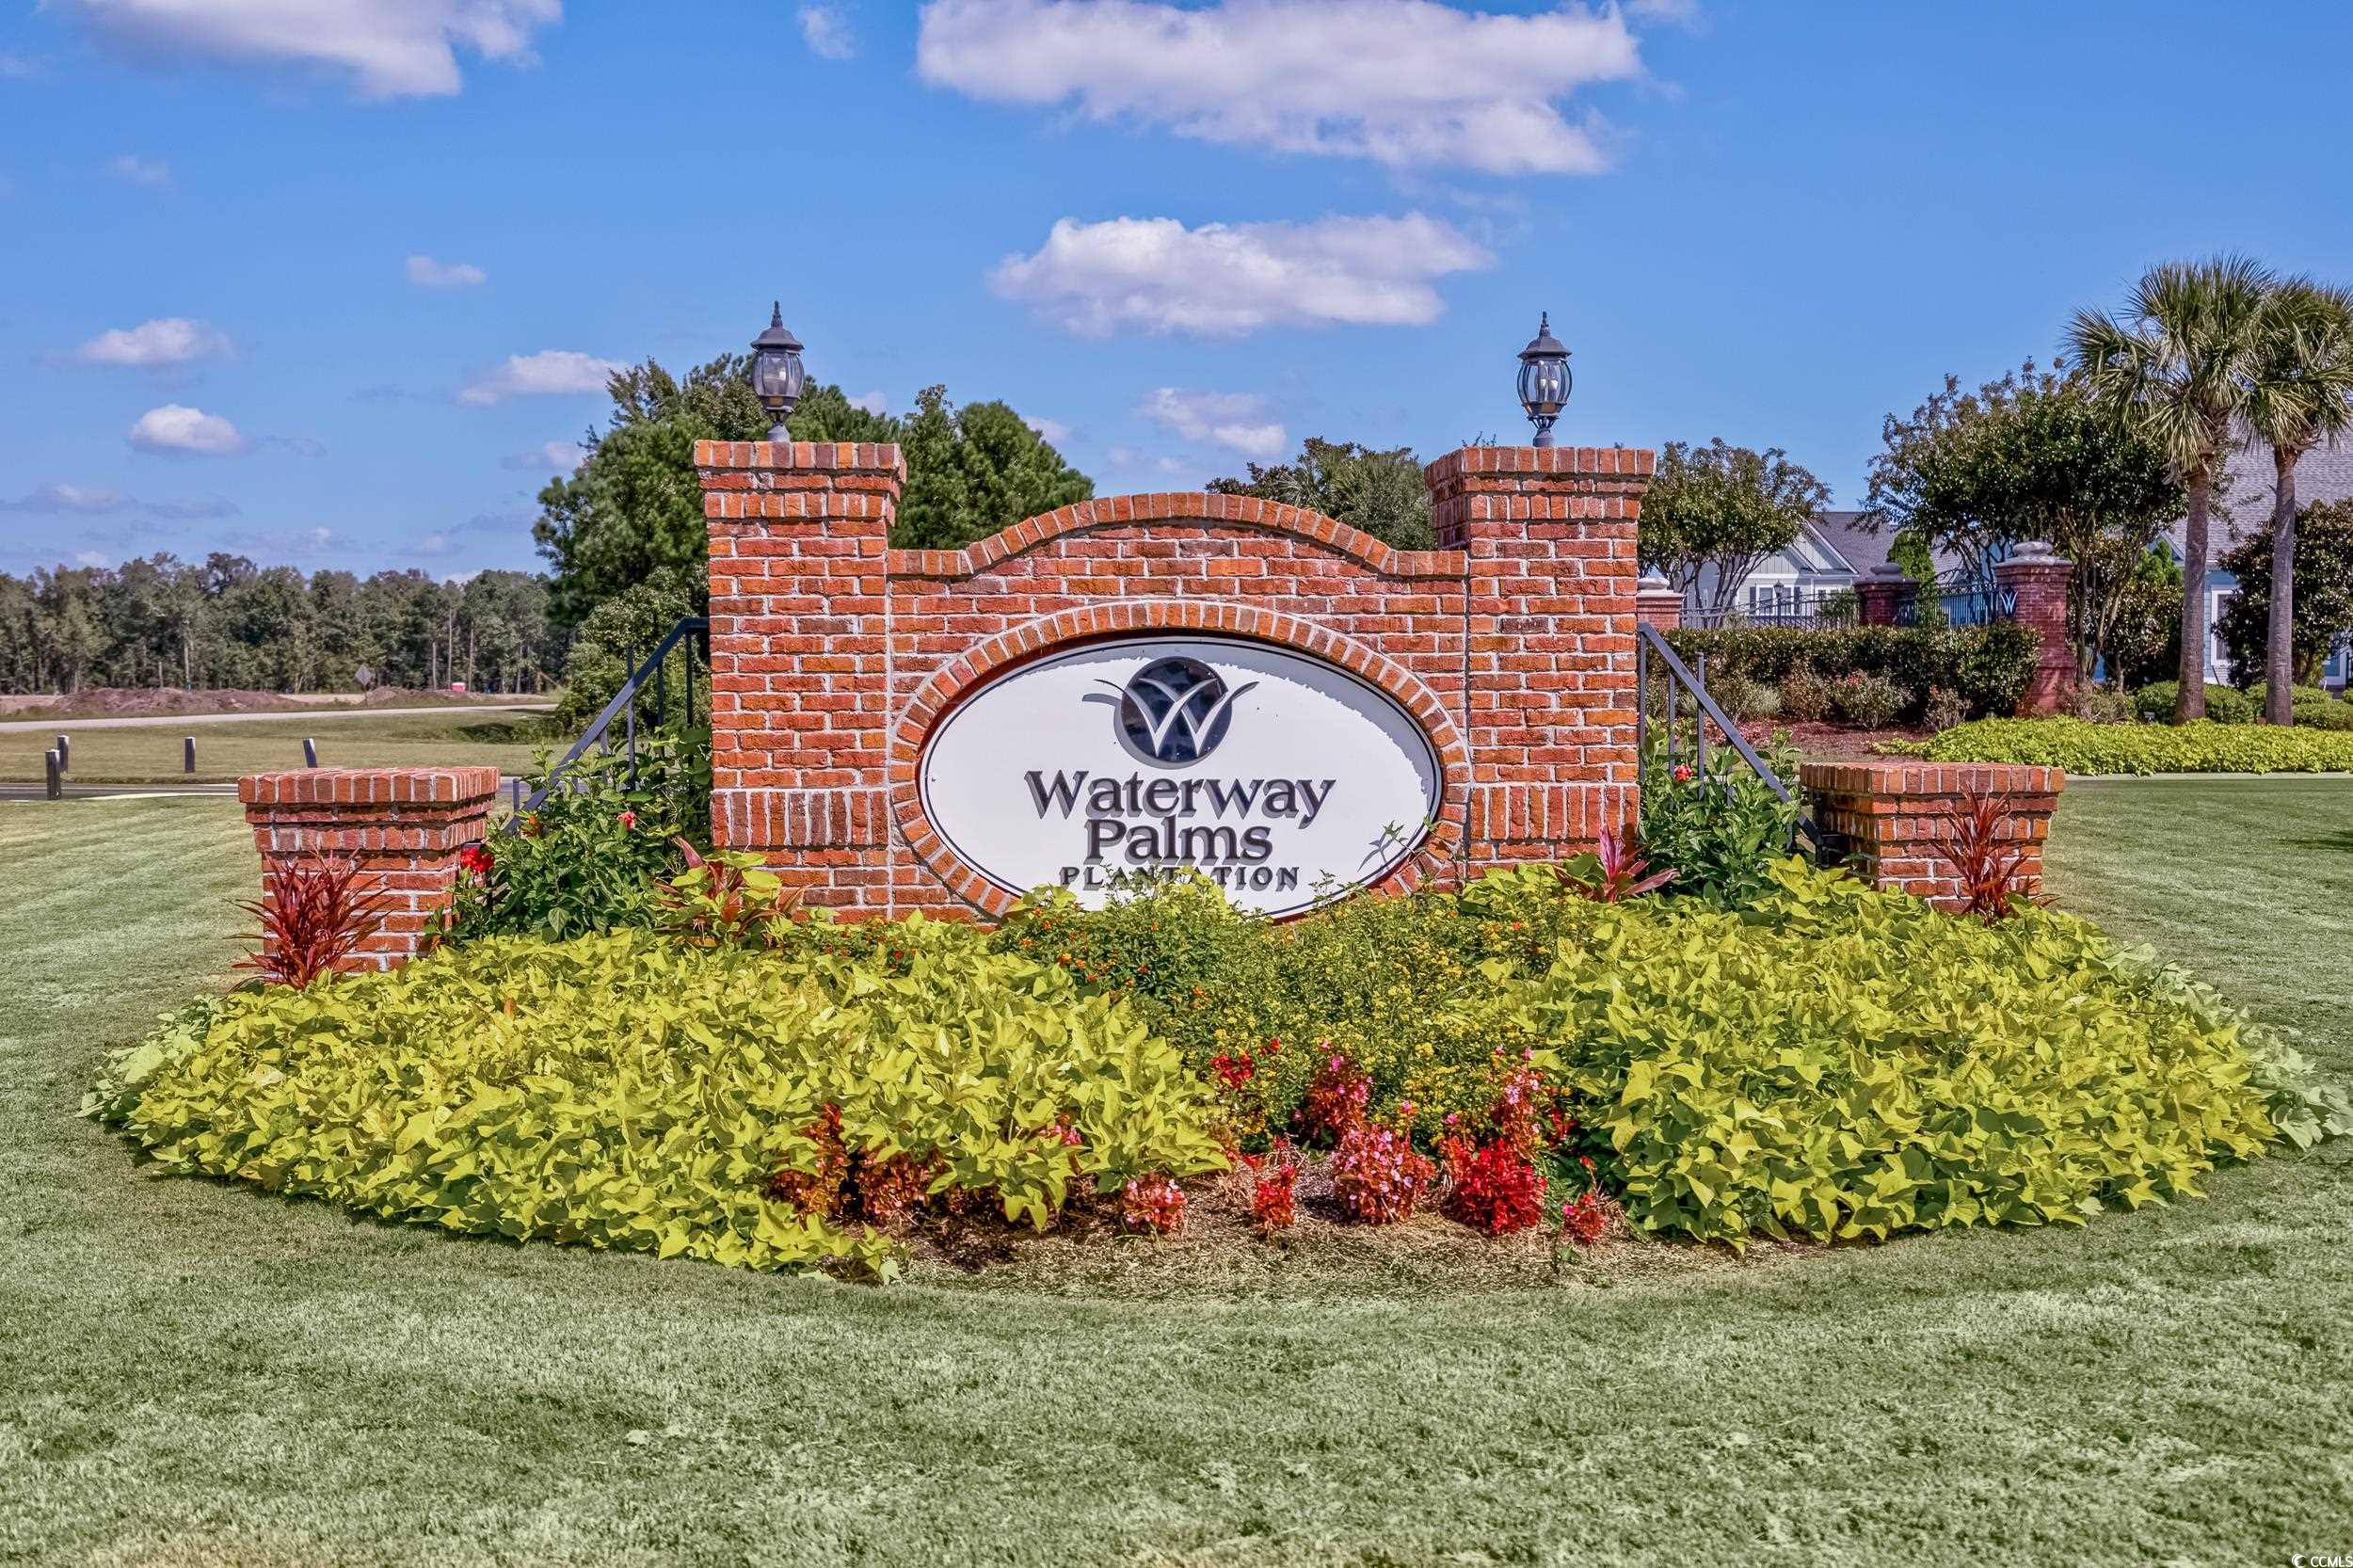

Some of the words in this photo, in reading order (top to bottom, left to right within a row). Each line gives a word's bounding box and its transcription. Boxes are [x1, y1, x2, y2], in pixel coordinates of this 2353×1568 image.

[1025, 770, 1337, 828] Waterway
[1084, 815, 1273, 864] Palms
[1060, 866, 1299, 888] PLATTION
